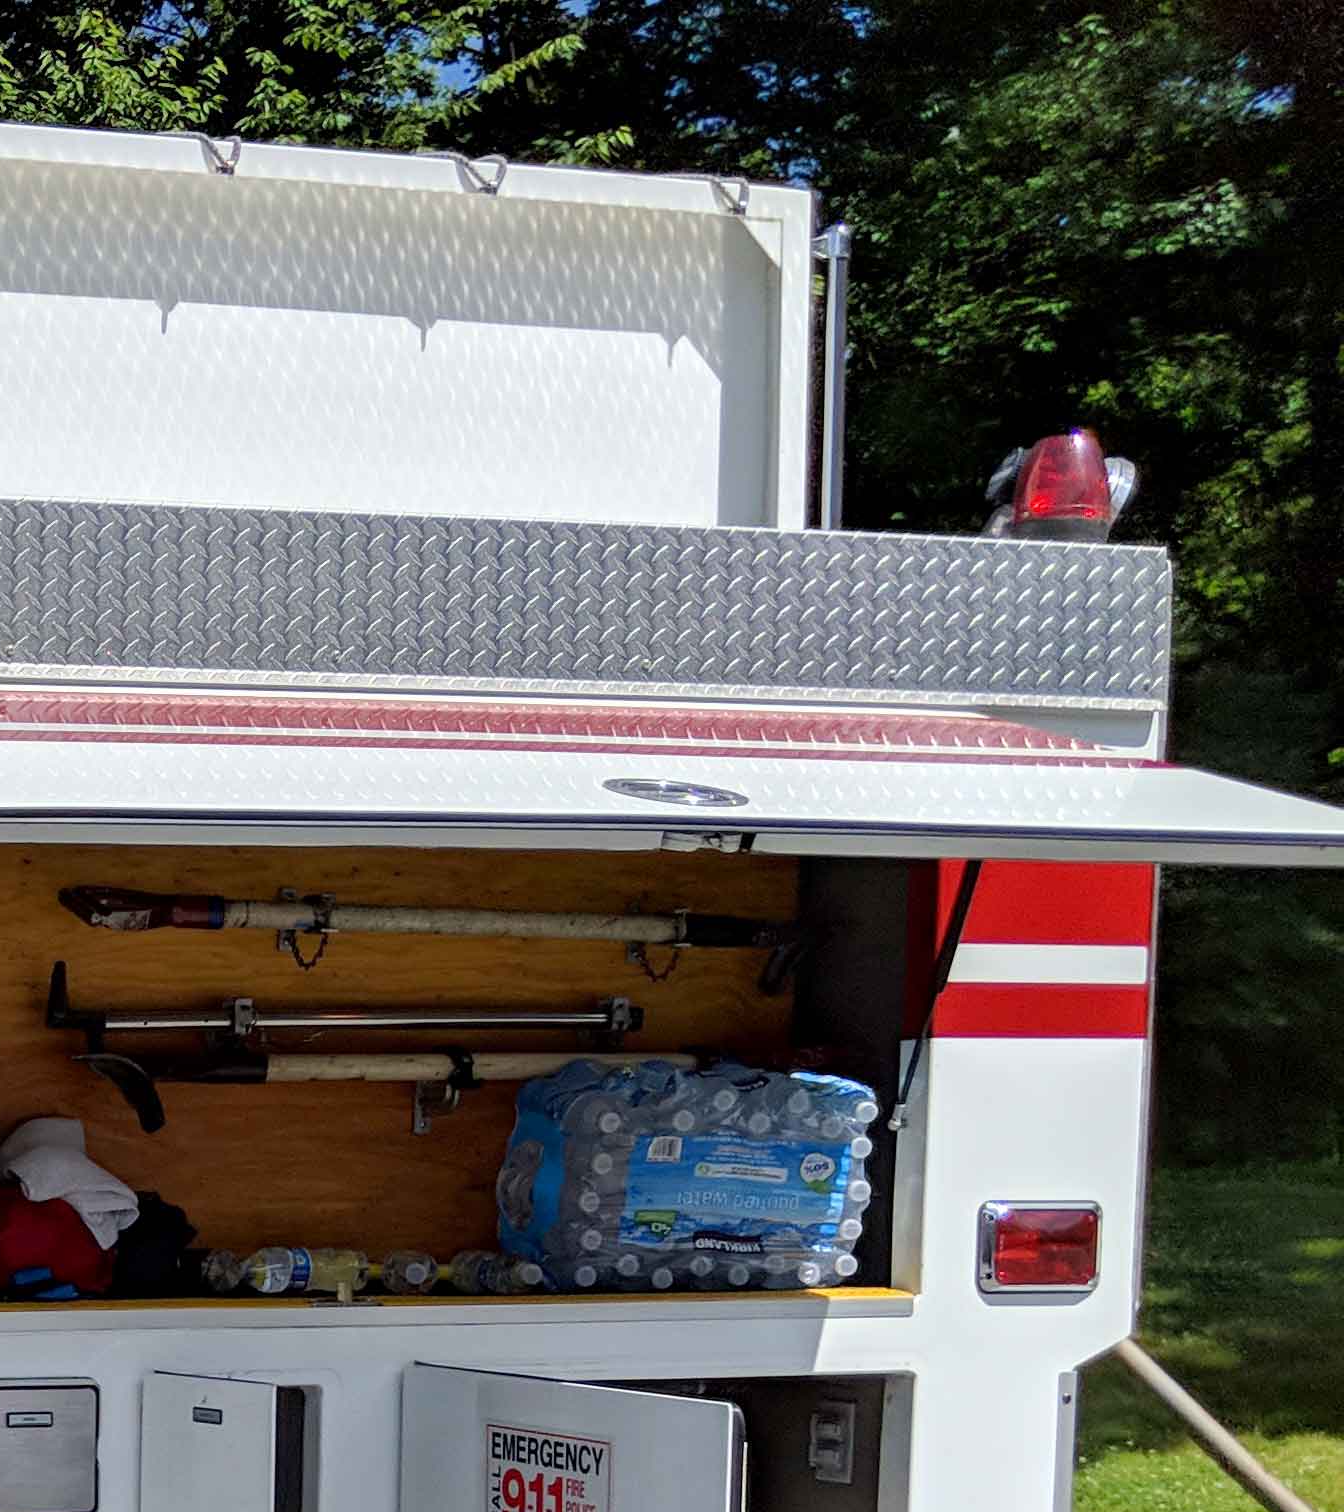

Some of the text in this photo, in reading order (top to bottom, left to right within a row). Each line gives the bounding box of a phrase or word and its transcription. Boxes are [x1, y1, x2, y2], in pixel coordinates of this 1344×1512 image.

[695, 1237, 761, 1253] KIRKLAND
[492, 1431, 604, 1476] EMERGENCY
[566, 1478, 585, 1499] FIRE
